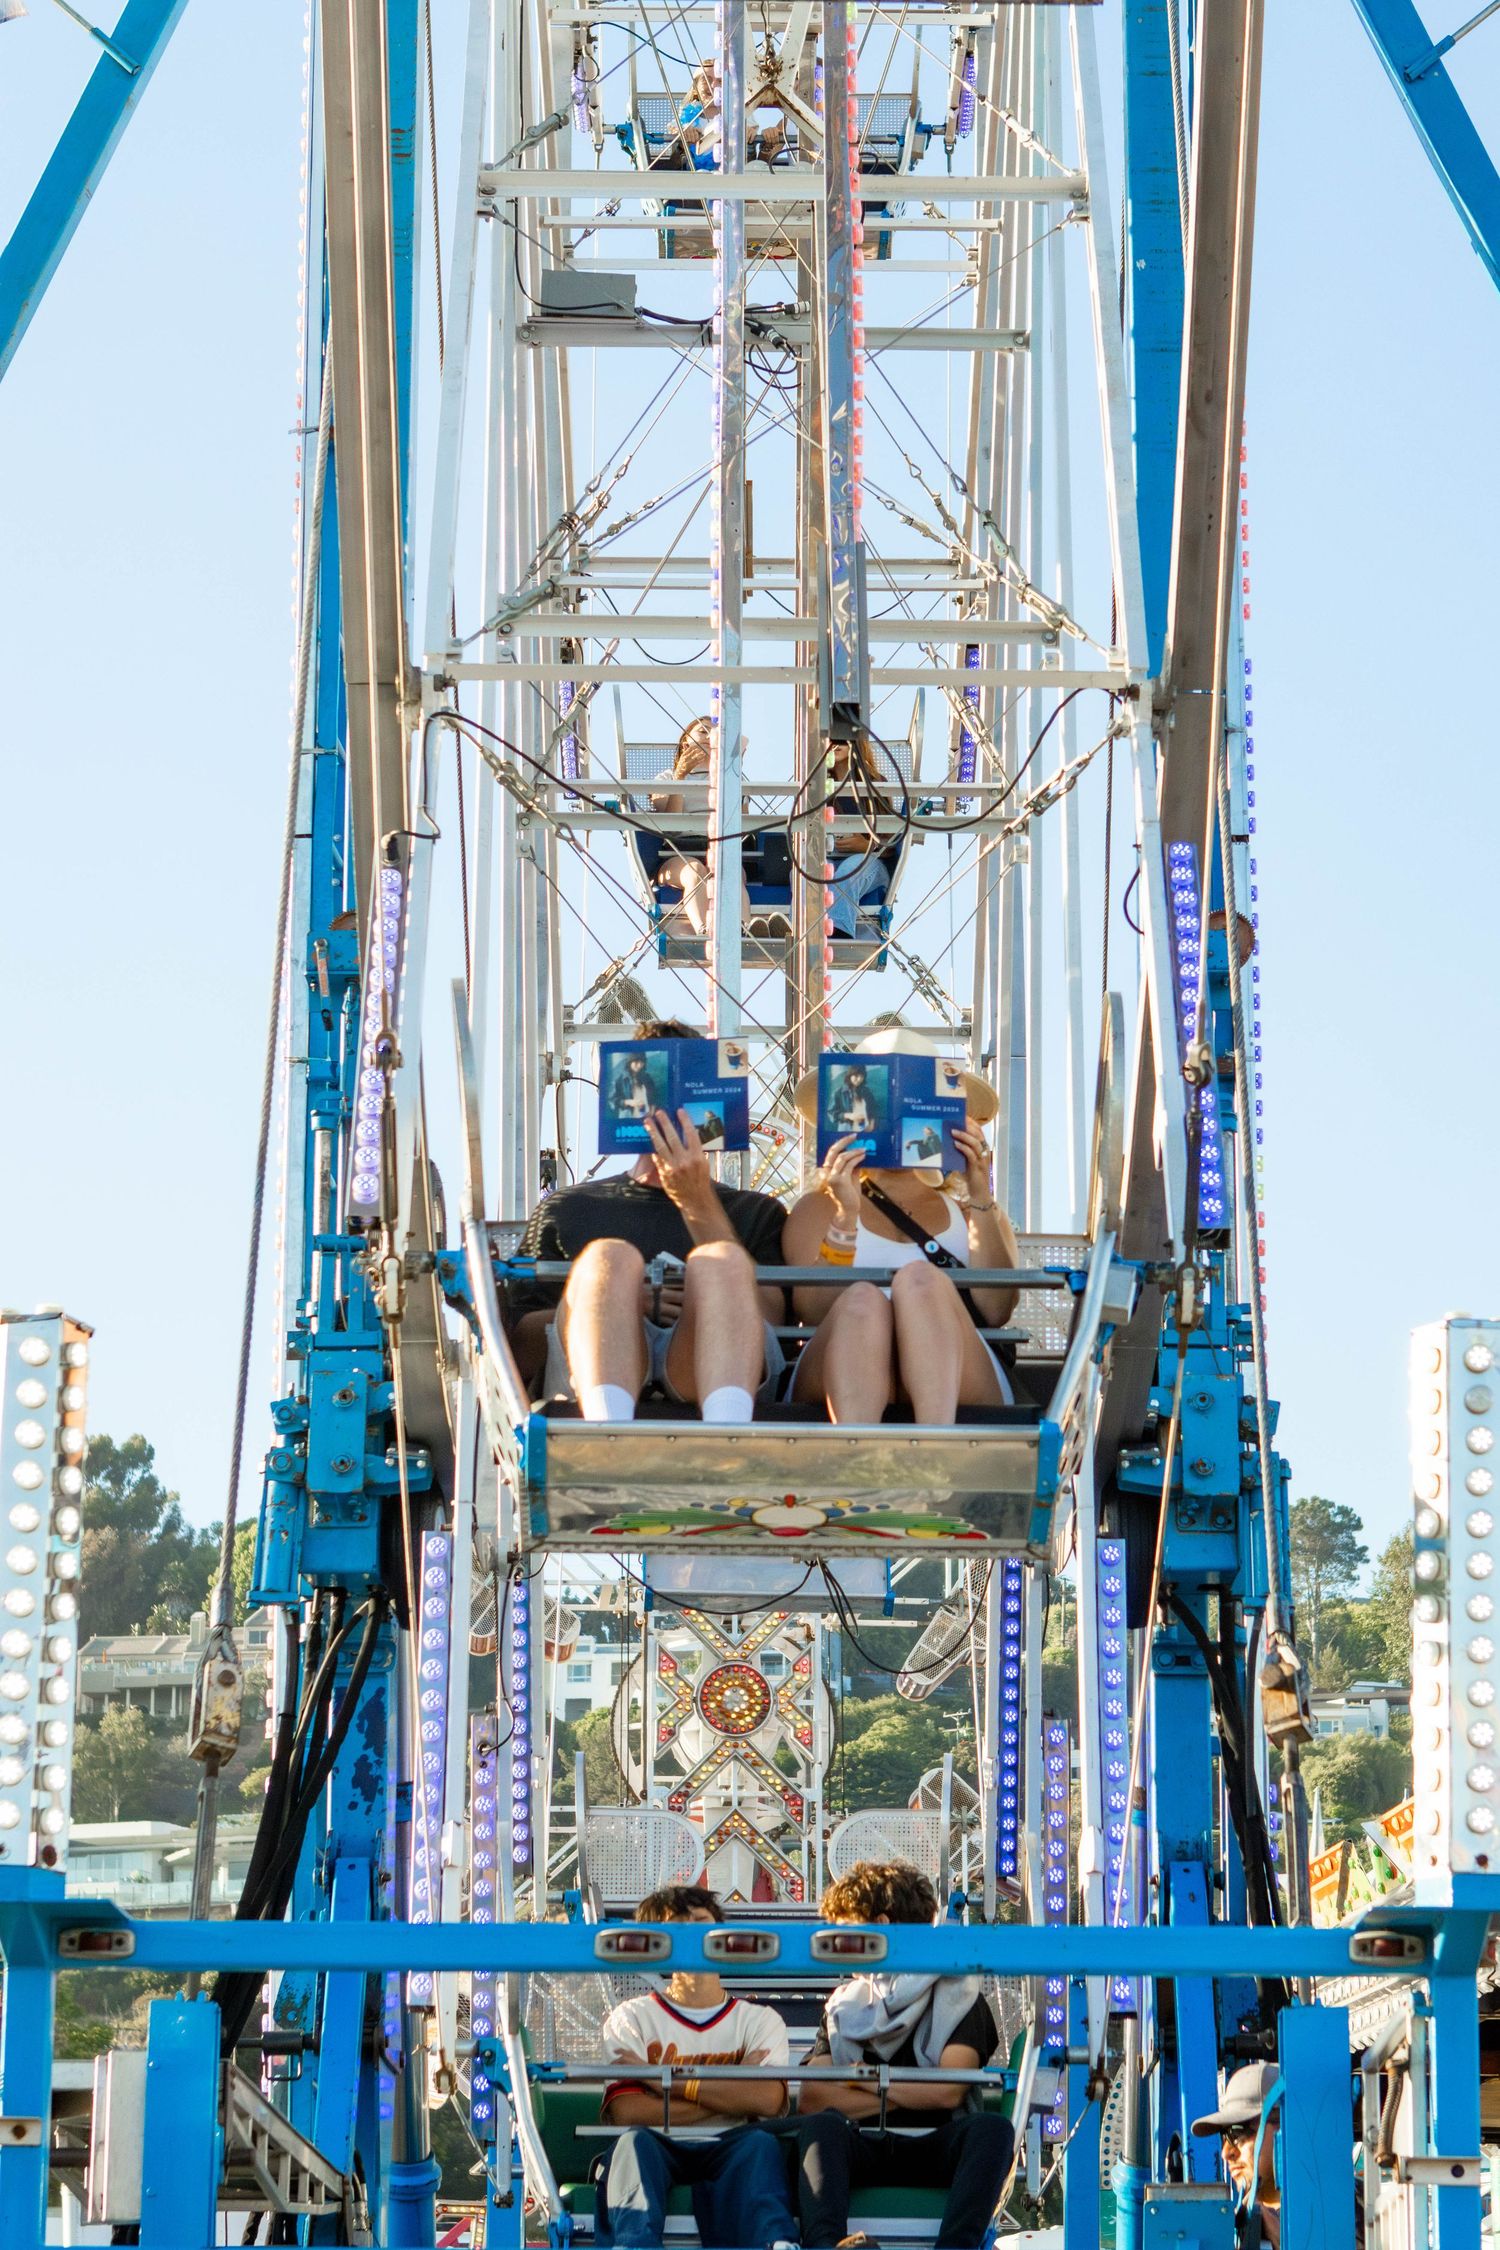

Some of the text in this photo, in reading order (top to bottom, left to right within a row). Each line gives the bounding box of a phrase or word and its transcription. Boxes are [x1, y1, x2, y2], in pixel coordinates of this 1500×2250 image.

[693, 1086, 741, 1095] SUMMER 2024
[911, 1104, 940, 1112] SUMMER
